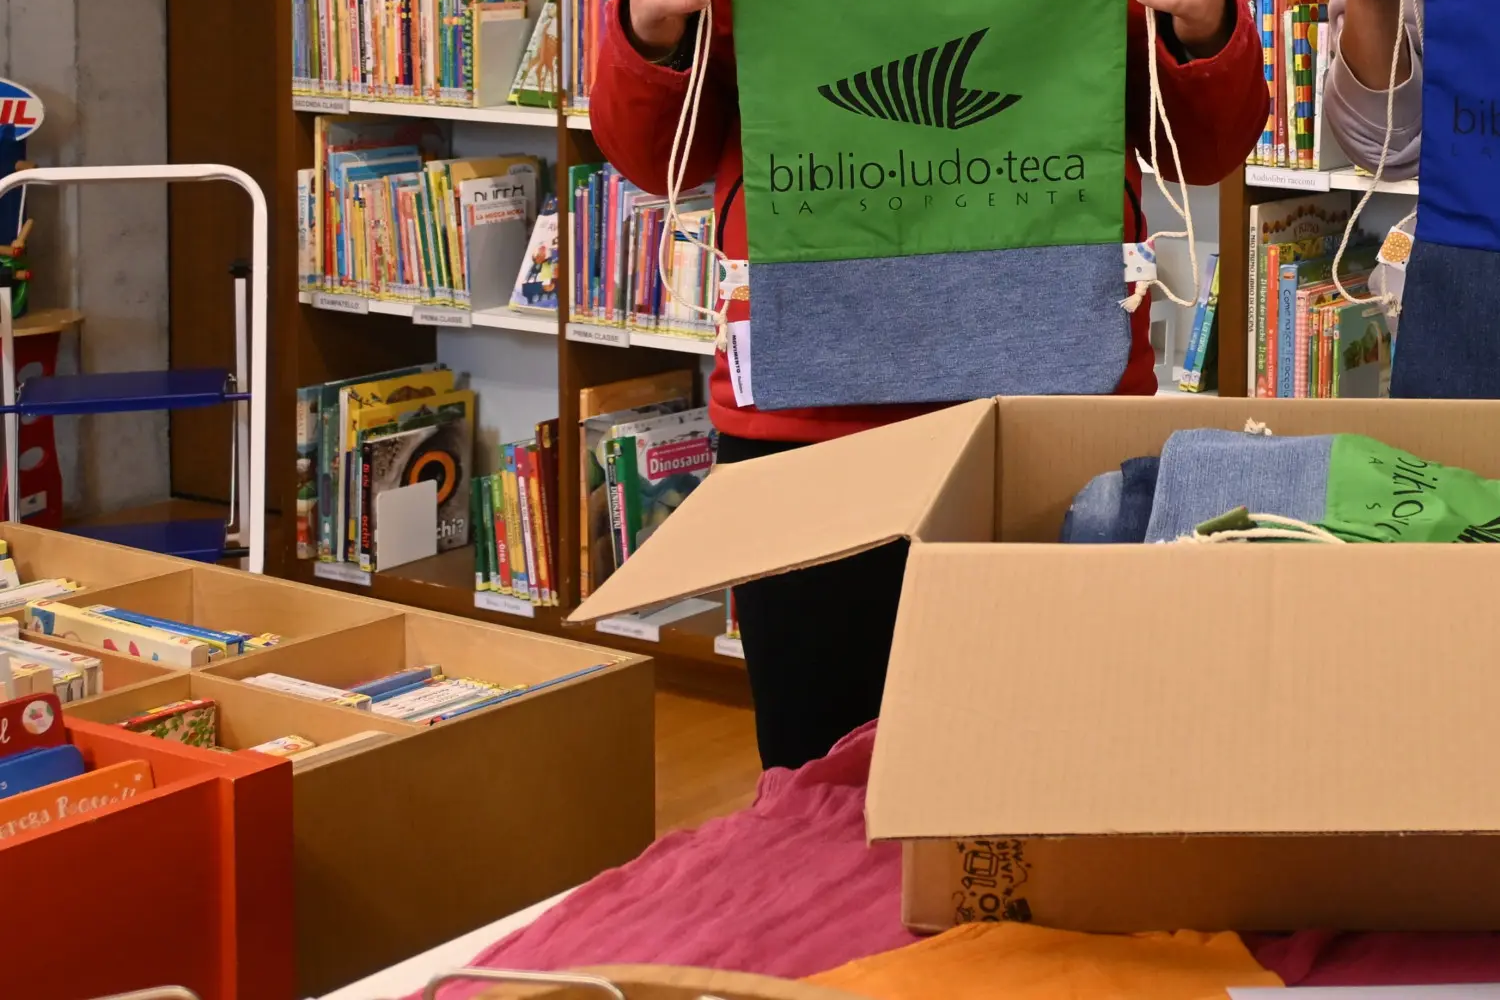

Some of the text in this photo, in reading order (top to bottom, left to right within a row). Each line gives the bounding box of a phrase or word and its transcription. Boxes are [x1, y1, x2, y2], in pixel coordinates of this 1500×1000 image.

[1250, 172, 1316, 187] Audiolibri racconti
[771, 188, 1087, 215] LA SORGENTE
[1283, 289, 1293, 317] Come
[732, 334, 741, 374] MOVIMENTO
[649, 447, 710, 475] Dinosauri
[610, 485, 621, 530] DINOSAURI
